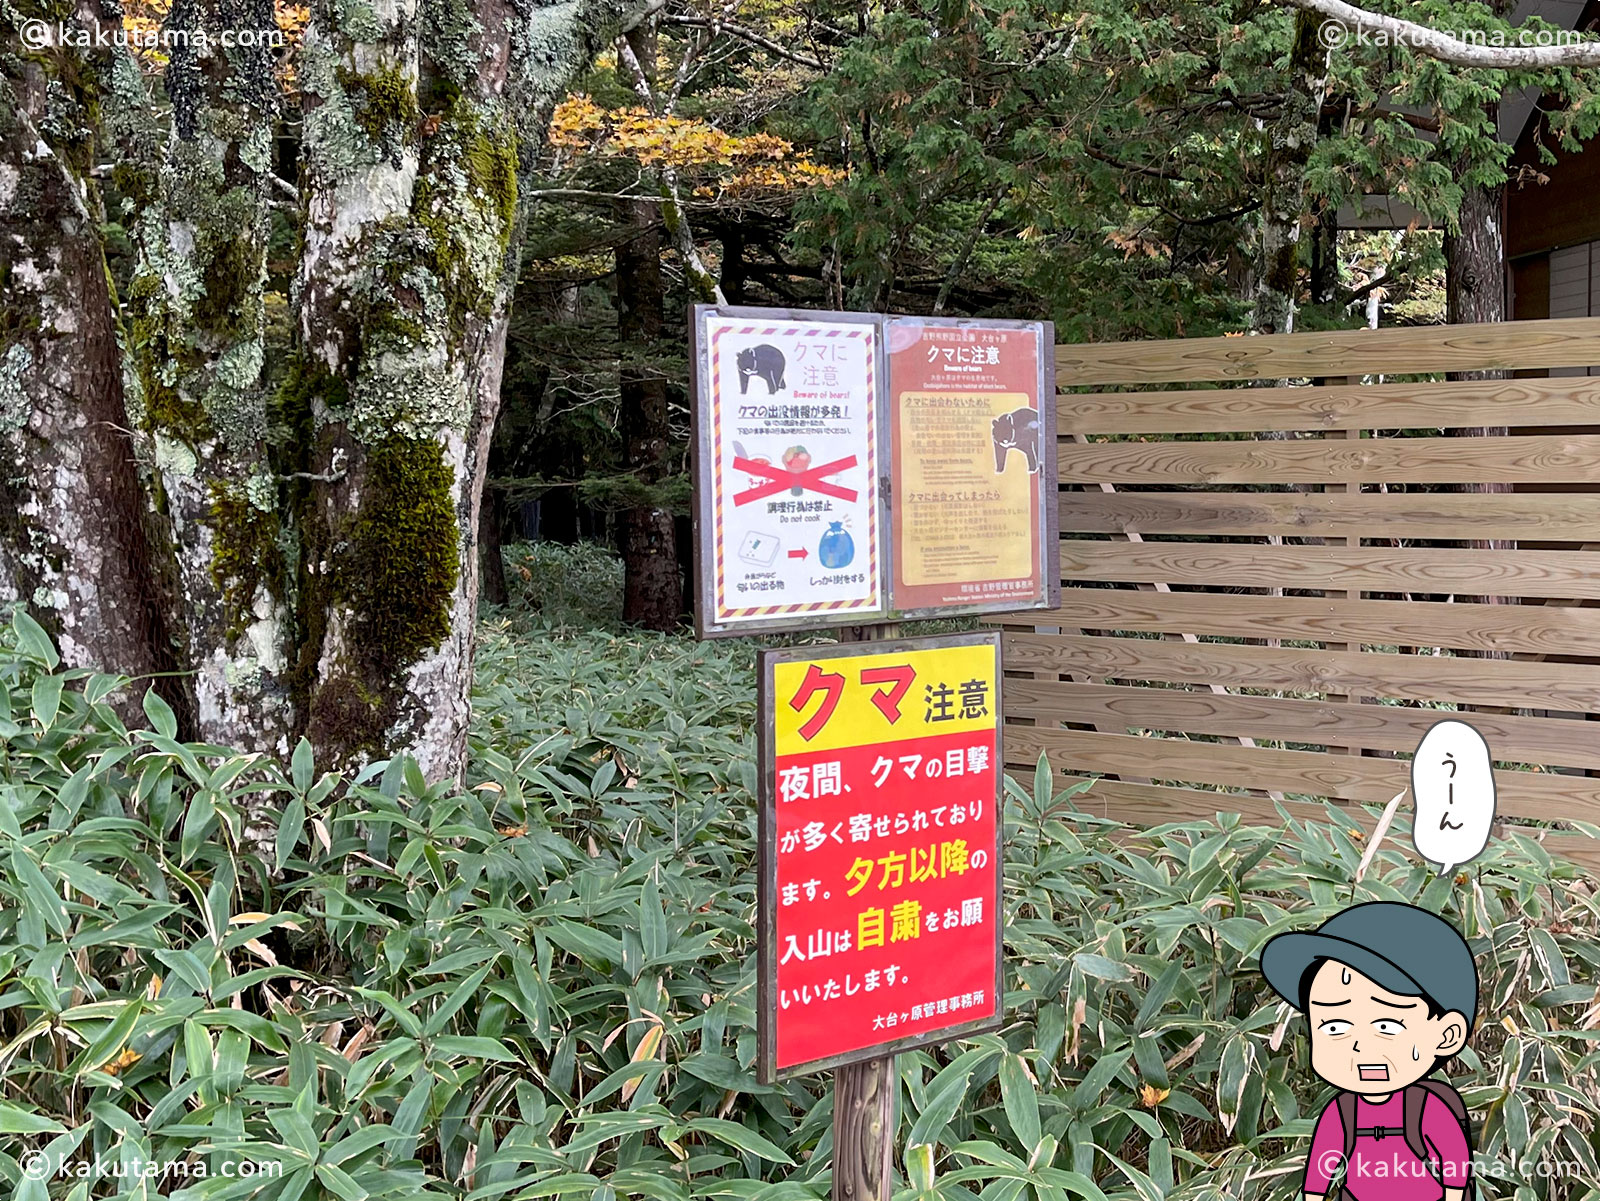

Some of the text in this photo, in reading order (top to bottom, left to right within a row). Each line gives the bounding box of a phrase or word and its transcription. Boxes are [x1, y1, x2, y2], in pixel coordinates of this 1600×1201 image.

[793, 341, 848, 362] クマに
[927, 344, 1000, 365] クマに注意
[802, 365, 840, 387] 注意
[793, 390, 818, 399] Beware
[819, 390, 828, 399] of
[905, 396, 991, 408] クマに出会わないために
[767, 499, 833, 514] 調理行為は禁止
[908, 489, 1001, 503] クマに出会ってしまったら
[779, 514, 821, 523] Do not cook
[809, 573, 865, 587] しっかり封をする
[780, 799, 984, 854] が多く寄せられており
[780, 897, 984, 965] 入山は自粛をお願
[780, 965, 910, 1010] いいたします。
[872, 990, 985, 1031] 大台ヶ原管理事務所
